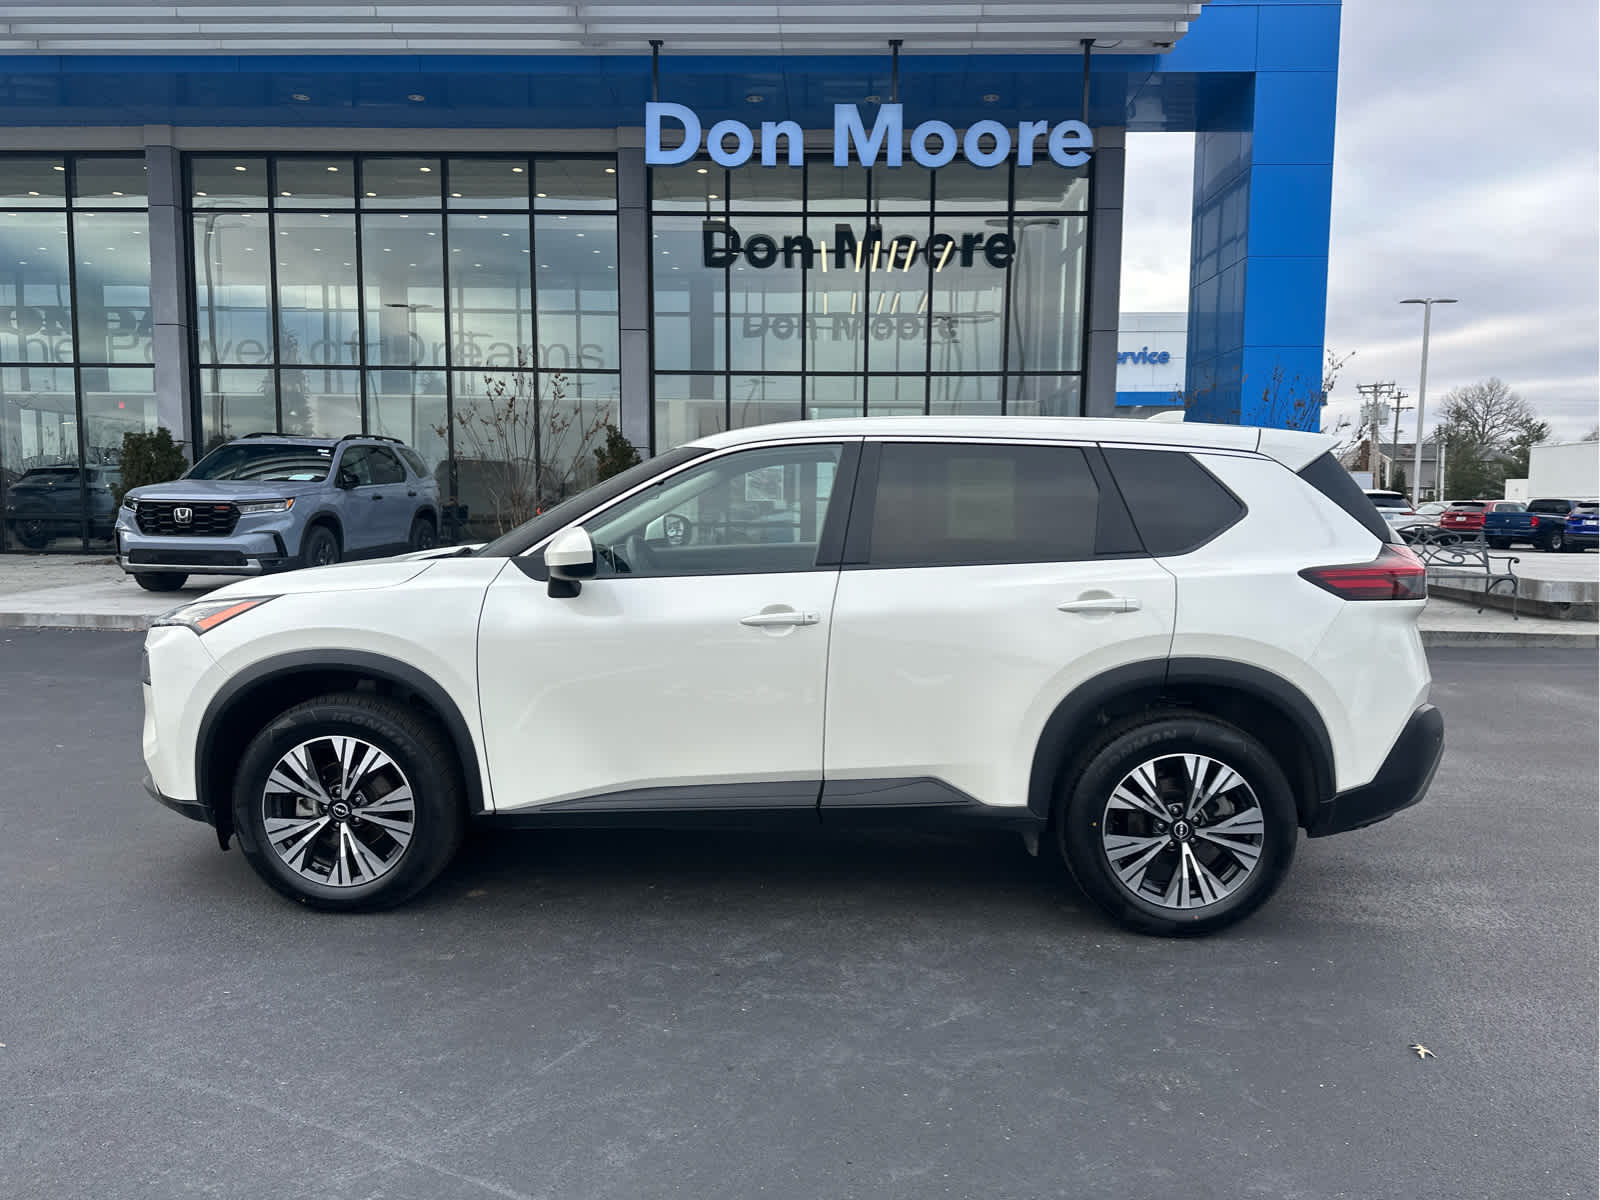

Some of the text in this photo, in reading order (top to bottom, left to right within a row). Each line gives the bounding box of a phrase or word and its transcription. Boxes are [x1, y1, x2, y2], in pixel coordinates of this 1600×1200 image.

[645, 102, 1094, 168] Don Moore
[702, 220, 1016, 269] Don Moore
